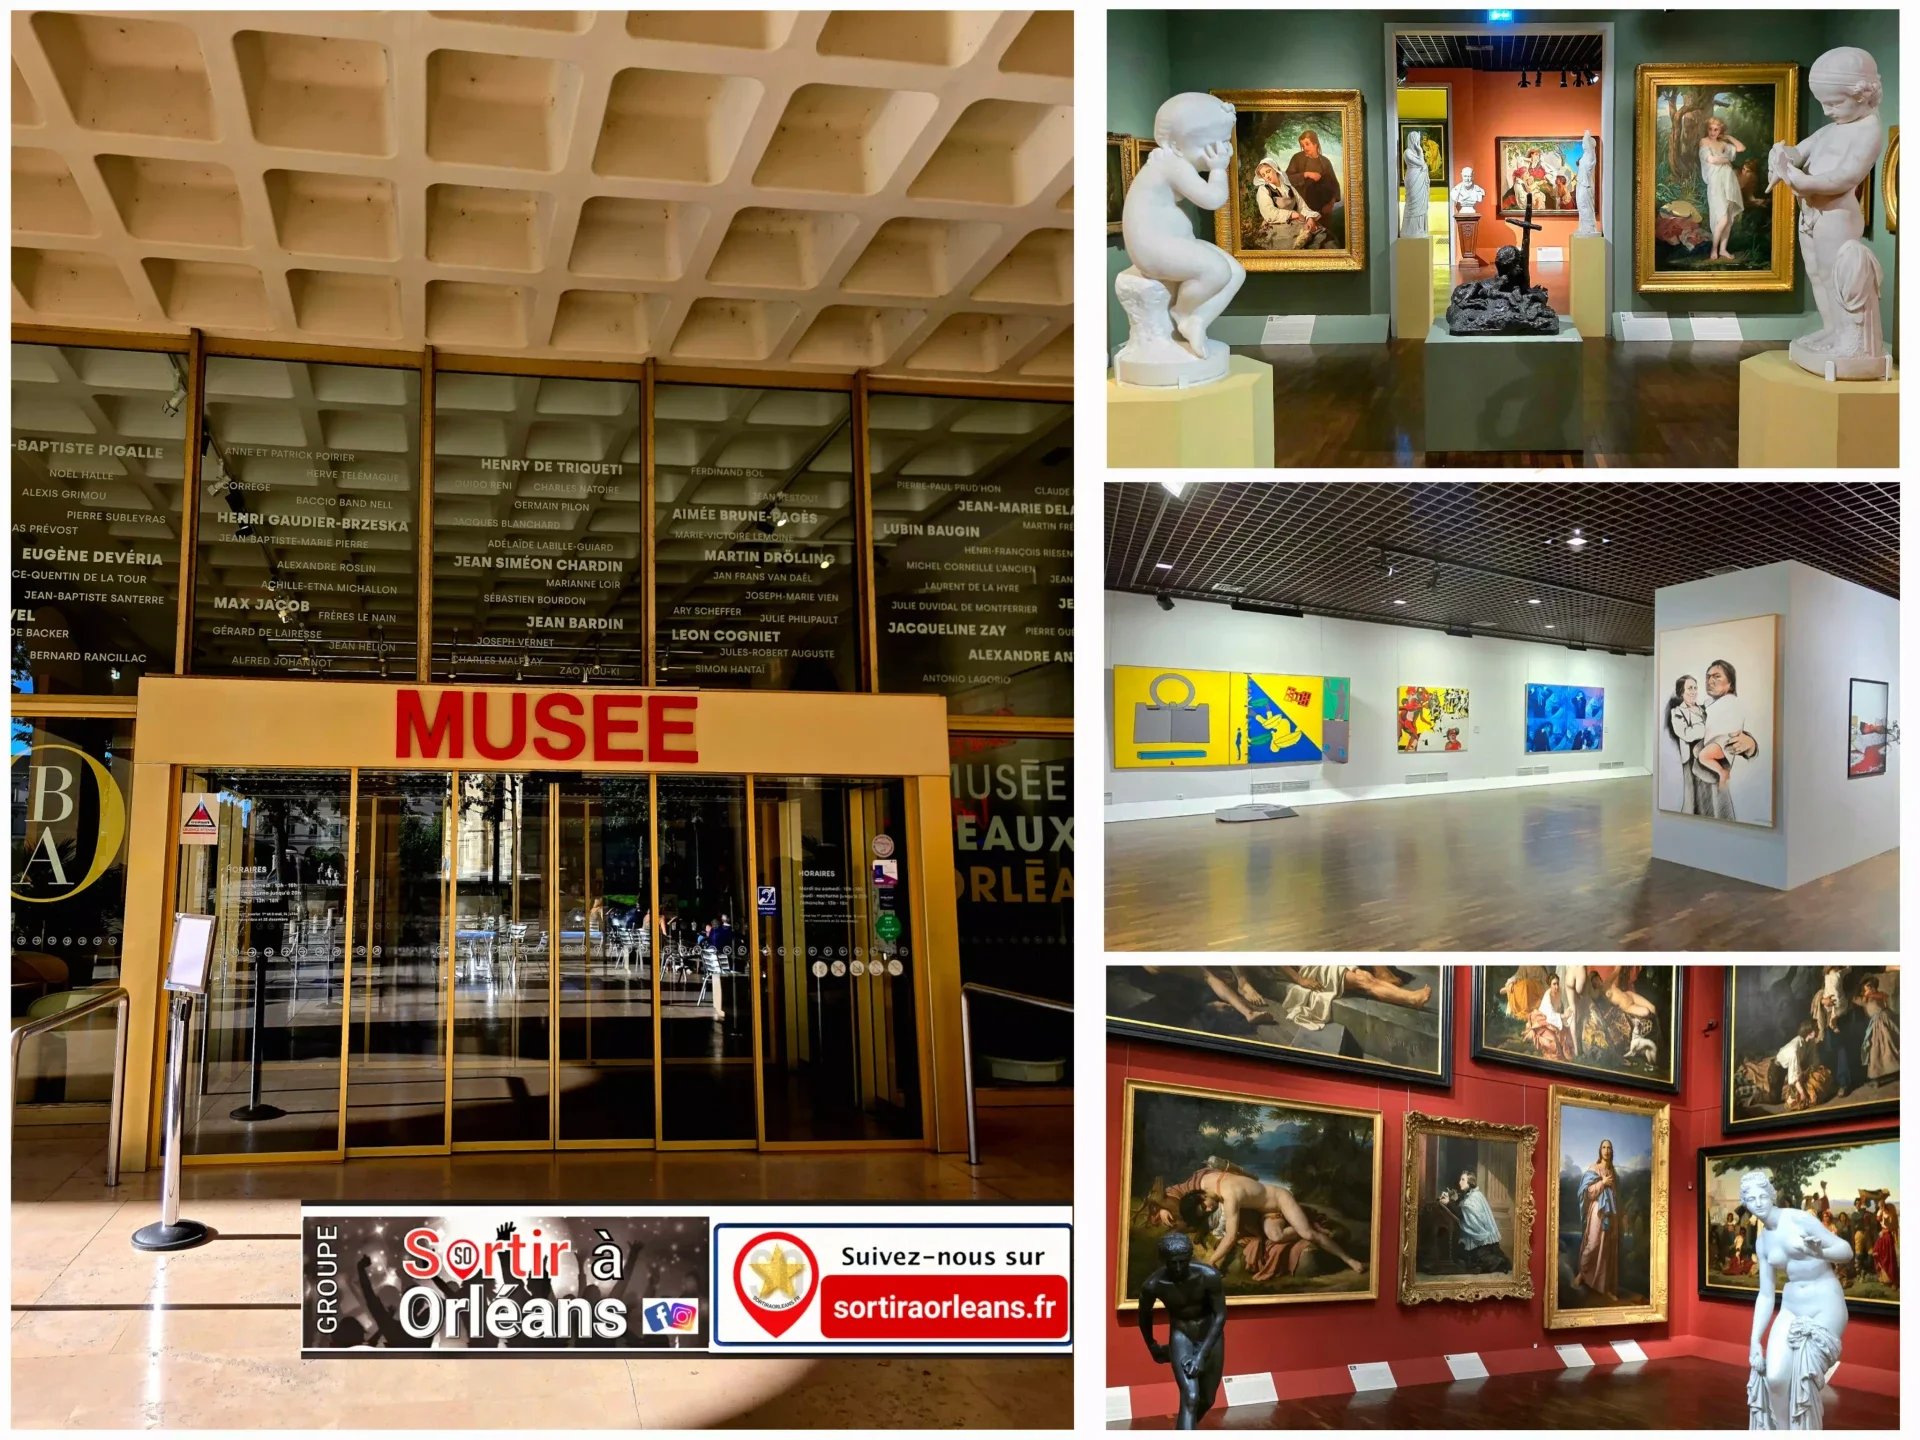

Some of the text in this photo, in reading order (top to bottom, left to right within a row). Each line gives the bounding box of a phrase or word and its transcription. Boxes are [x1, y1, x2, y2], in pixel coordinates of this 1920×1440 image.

[99, 445, 163, 459] PIGALLE
[225, 447, 252, 456] ANNE
[272, 450, 312, 459] PATRICK
[316, 452, 354, 462] POIRIER
[482, 459, 622, 475] HENRY DE TRIQUETI
[691, 467, 743, 477] FERDINAND
[491, 482, 512, 490] RENI
[534, 483, 619, 494] CHARLES NATOIRE
[897, 481, 951, 492] PIERRE-PAUL
[1035, 487, 1070, 496] CLAUDE
[22, 488, 107, 500] ALEXIS GRIMOU
[296, 496, 393, 509] BACCIO BAND NELL
[515, 501, 589, 511] GERMAIN PILON
[958, 501, 1041, 514] JEAN-MARIE
[67, 511, 166, 523] PIERRE SUBLEYRAS
[673, 506, 716, 520] AIMÉE
[218, 512, 409, 532] HENRI GAUDIER-BRZESKA
[453, 518, 560, 529] JACQUES BLANCHARD
[1023, 522, 1056, 530] MARTIN
[30, 523, 78, 534] PRÉVOST
[883, 524, 980, 537] LUBIN BAUGIN
[675, 531, 794, 541] MARIE-VICTOIRE LEMOINE
[336, 540, 368, 548] PIERRE
[537, 541, 613, 552] LABILLE-GUIARD
[23, 546, 162, 565] EUGÈNE DEVÉRIA
[704, 549, 835, 564] MARTIN DRÖLLING
[277, 561, 376, 573] ALEXANDRE ROSLIN
[454, 555, 622, 572] JEAN SIMÉON CHARDIN
[907, 561, 941, 570] MICHEL
[944, 563, 993, 572] CORNEILLE
[84, 573, 97, 581] DE
[101, 574, 114, 582] LA
[118, 574, 146, 583] TOUR
[735, 572, 765, 581] FRANS
[261, 580, 397, 594] ACHILLE-ETNA MICHALLON
[546, 580, 620, 589] MARIANNE LOIR
[925, 582, 965, 592] LAURENT
[968, 583, 979, 592] DE
[997, 584, 1019, 593] HYRE
[24, 591, 164, 604] JEAN-BAPTISTE SANTERRE
[484, 593, 586, 605] SÉBASTIEN BOURDON
[746, 592, 814, 601] JOSEPH-MARIE
[214, 597, 310, 612] MAX JACOB
[892, 601, 1037, 613] JULIE DUVIDAL DE MONTFERRIER
[319, 610, 396, 622] FRÈRES LE NAIN
[695, 607, 741, 616] SCHEFFER
[527, 617, 623, 629] JEAN BARDIN
[788, 615, 839, 624] PHILIPAULT
[26, 629, 69, 638] BACKER
[213, 624, 255, 636] GÉRARD
[276, 629, 322, 638] LAIRESSE
[888, 622, 1006, 636] JACQUELINE ZAY
[1025, 627, 1055, 636] PIERRE
[672, 629, 780, 642] LEON COGNIET
[329, 642, 355, 650] JEAN
[477, 637, 554, 647] JOSEPH VERNET
[30, 651, 146, 663] BERNARD RANCILLAC
[720, 648, 835, 658] JULES-ROBERT AUGUSTE
[968, 649, 1049, 661] ALEXANDRE
[232, 656, 270, 665] ALFRED
[560, 667, 619, 676] ZAO WOU-KI
[696, 665, 727, 673] SIMON
[923, 674, 1011, 684] ANTONIO LAGORIO
[396, 690, 698, 763] MUSEE
